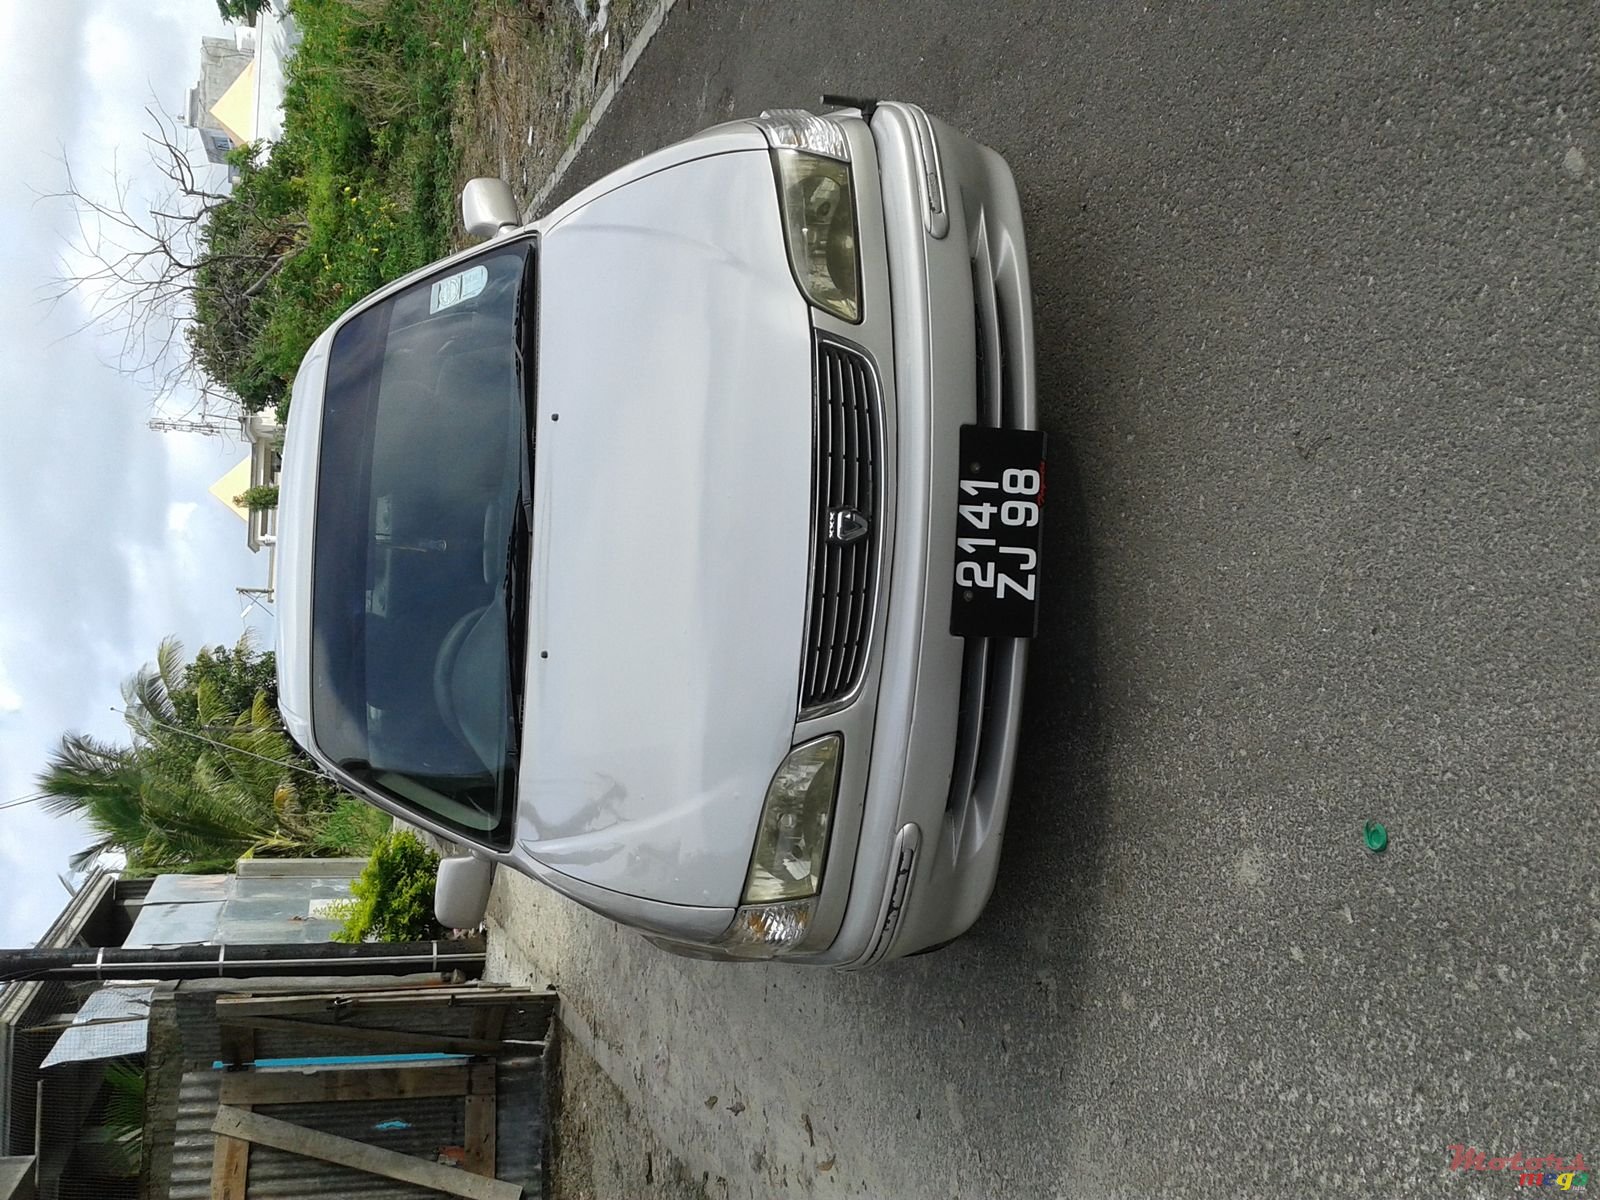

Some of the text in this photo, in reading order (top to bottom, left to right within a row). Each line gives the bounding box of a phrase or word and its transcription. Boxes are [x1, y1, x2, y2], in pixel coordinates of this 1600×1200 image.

[956, 480, 998, 587] 2141
[996, 468, 1040, 601] ZJ 98
